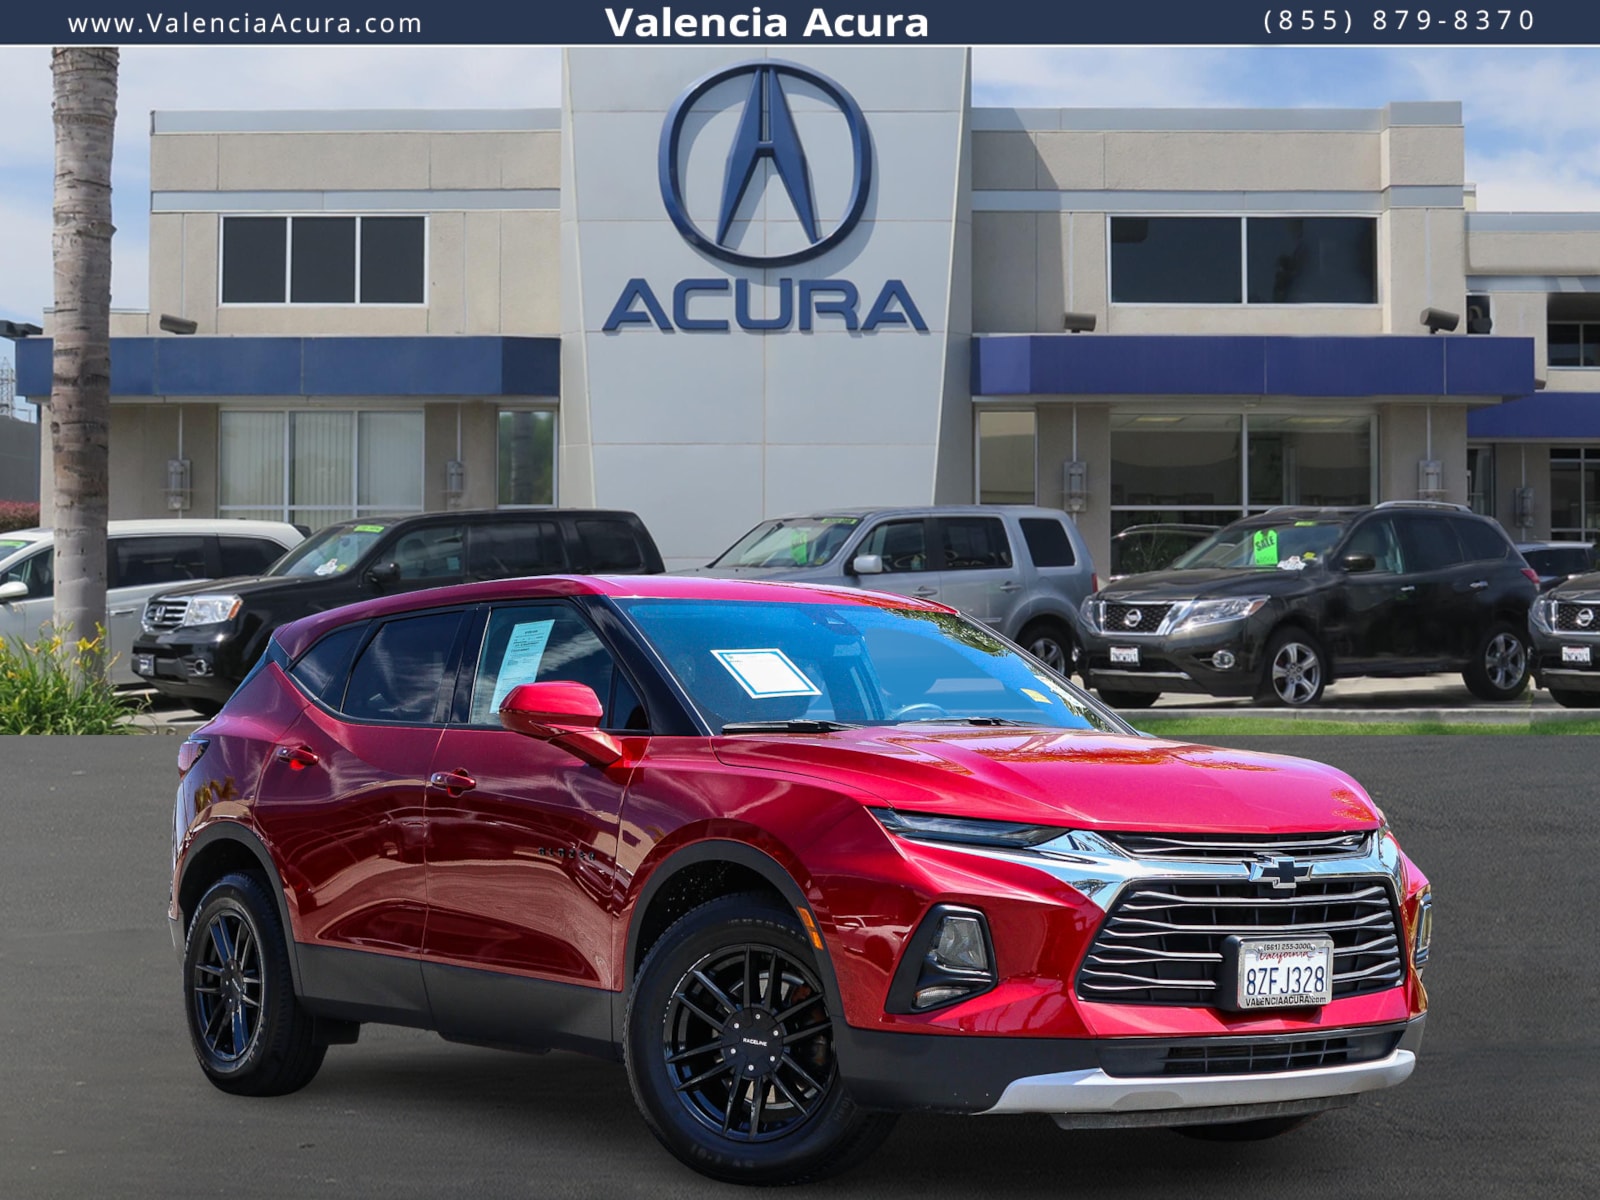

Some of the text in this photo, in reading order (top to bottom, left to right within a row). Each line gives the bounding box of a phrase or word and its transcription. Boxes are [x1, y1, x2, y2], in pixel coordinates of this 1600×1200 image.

[602, 278, 929, 331] ACURA
[1255, 535, 1275, 552] SALE
[1246, 966, 1325, 996] 8ZFJ328
